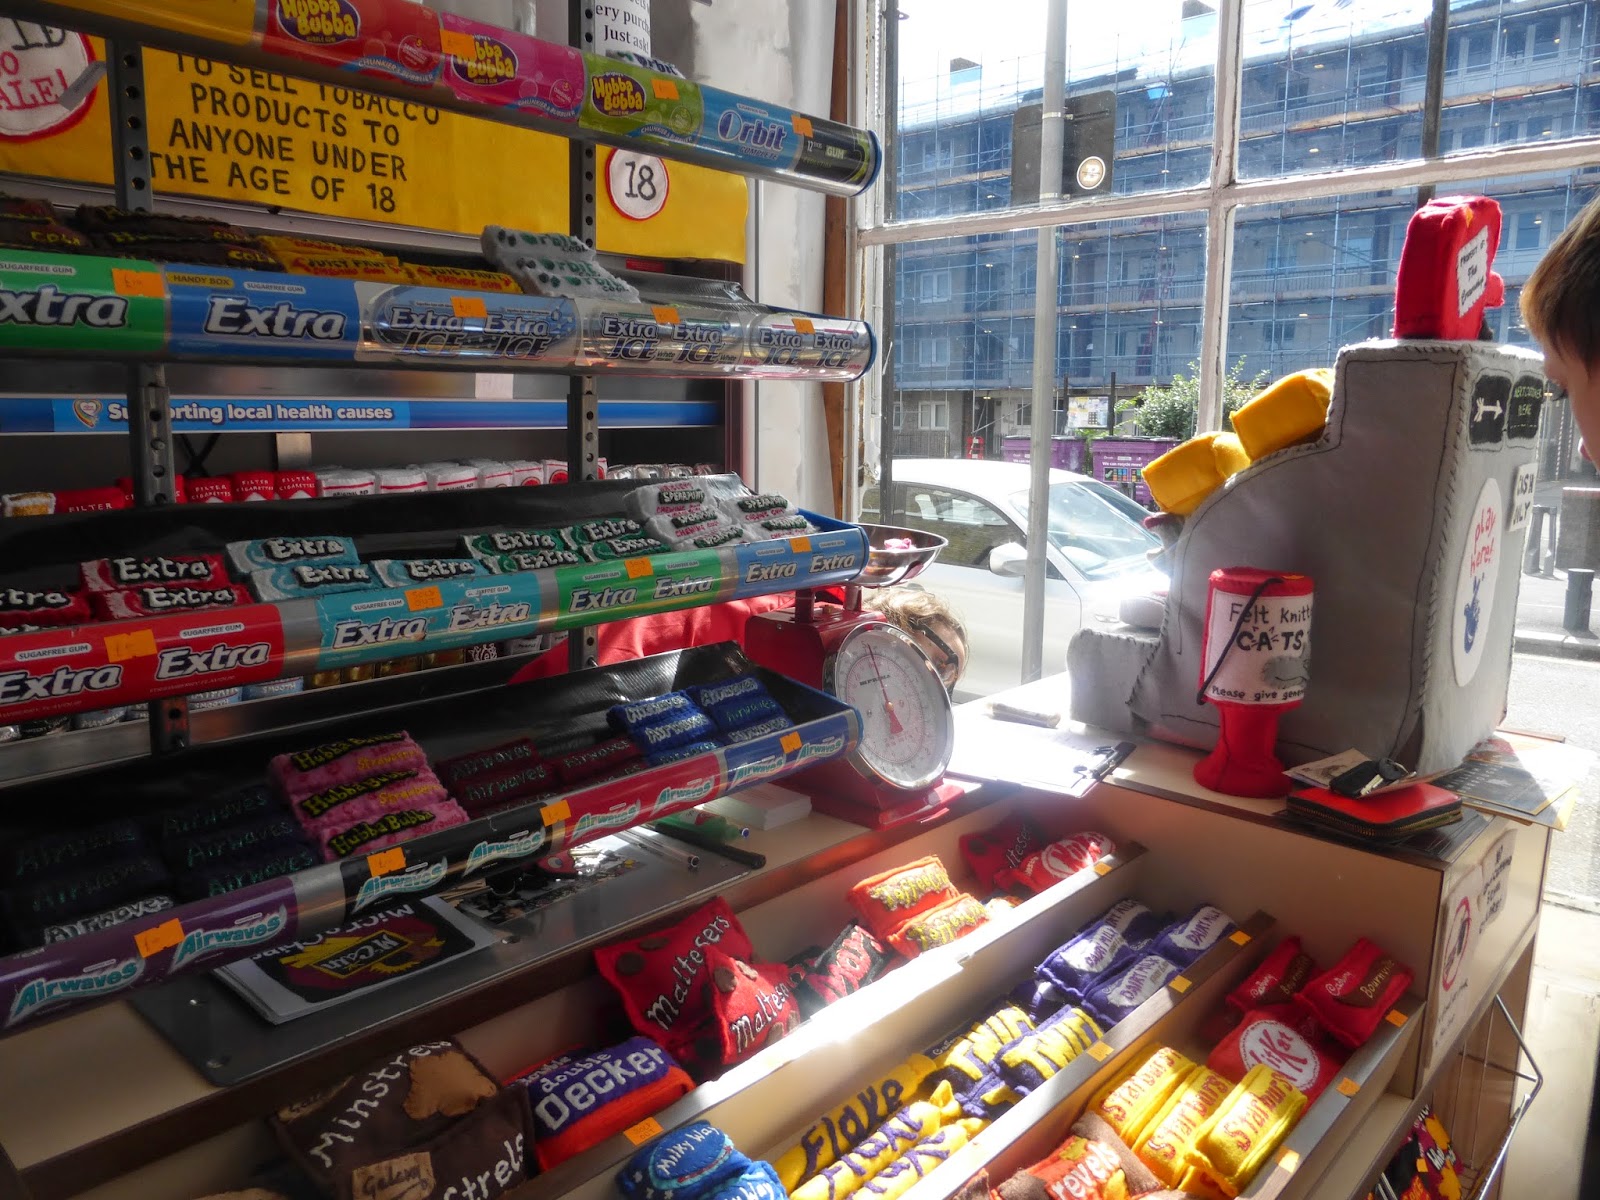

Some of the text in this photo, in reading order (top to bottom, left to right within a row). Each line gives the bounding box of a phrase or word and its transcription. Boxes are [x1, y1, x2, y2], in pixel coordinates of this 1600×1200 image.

[296, 15, 356, 38] Bubba
[594, 5, 620, 21] ery
[603, 25, 649, 55] Just ask!
[467, 58, 516, 79] Bubba
[0, 68, 69, 111] ALE!
[176, 54, 440, 125] TO SELL TOBACCO
[592, 77, 634, 99] Hubba
[603, 91, 643, 112] Bubba
[190, 82, 400, 146] PRODUCTS TO
[718, 110, 787, 151] Orbit
[168, 117, 408, 182] ANYONE UNDER
[807, 141, 814, 153] 12
[826, 147, 846, 158] GUM
[149, 152, 396, 213] THE AGE OF 18
[624, 160, 658, 200] 18
[172, 275, 231, 287] HANDY BOX
[246, 283, 287, 291] SUGARFREE
[0, 285, 128, 328] xtra
[205, 297, 346, 340] Extra
[390, 306, 549, 337] Extra Extra
[602, 316, 722, 344] Extra Extra
[401, 331, 553, 361] ICE ICE
[609, 337, 724, 364] ICE ICE
[760, 328, 851, 351] Extra Extra
[762, 347, 851, 369] ICE ICE
[108, 403, 223, 424] Suorting
[228, 404, 272, 420] local
[277, 404, 333, 420] health
[337, 406, 394, 420] causes
[194, 483, 228, 493] FILTER
[241, 478, 270, 486] FILTER
[281, 475, 312, 484] FILTER
[494, 531, 556, 551] Extra
[583, 519, 641, 542] Extra
[1474, 507, 1497, 554] play
[265, 537, 345, 559] Extra
[610, 537, 662, 553] Extra
[1469, 538, 1495, 577] here!
[112, 556, 210, 582] Extra
[301, 564, 370, 584] Extra
[408, 559, 474, 578] Extra
[516, 551, 579, 570] Extra
[745, 562, 798, 584] Extra
[809, 554, 857, 574] Extra
[142, 586, 236, 608] Extra
[497, 585, 510, 593] GUM
[568, 585, 638, 614] Extra
[653, 574, 713, 600] Extra
[353, 599, 403, 611] SUGARFREE GUM
[449, 603, 530, 632] Extra
[1228, 603, 1270, 625] Felt
[182, 623, 242, 637] SUGARFREE GUM
[332, 617, 427, 649] Extra
[1235, 629, 1304, 652] CATS
[18, 644, 89, 660] SUGARFREE GUM
[155, 643, 272, 682] Extra
[0, 665, 123, 703] Extra
[1211, 685, 1278, 702] Please give
[293, 742, 351, 772] Hubba
[798, 740, 844, 762] Airwaves
[732, 758, 784, 784] Airwaves
[302, 782, 368, 817] Hubba
[653, 780, 712, 812] Airwaves
[329, 822, 388, 857] Hubba
[384, 810, 436, 831] Bubba
[572, 804, 638, 838] Airwaves
[465, 832, 543, 872] Airwaves
[354, 861, 444, 906] Airwaves
[172, 914, 282, 968] Airwaves
[1185, 919, 1207, 945] DAIRY
[646, 914, 731, 1031] Maltesers
[12, 960, 139, 1019] Airwaves
[1119, 972, 1144, 1001] DAIRY
[540, 1051, 612, 1093] double
[534, 1046, 665, 1132] Decker
[309, 1039, 454, 1169] Minstrels
[1223, 1065, 1297, 1153] Starburs
[656, 1124, 721, 1176] Milky Way
[1051, 1141, 1123, 1200] revels
